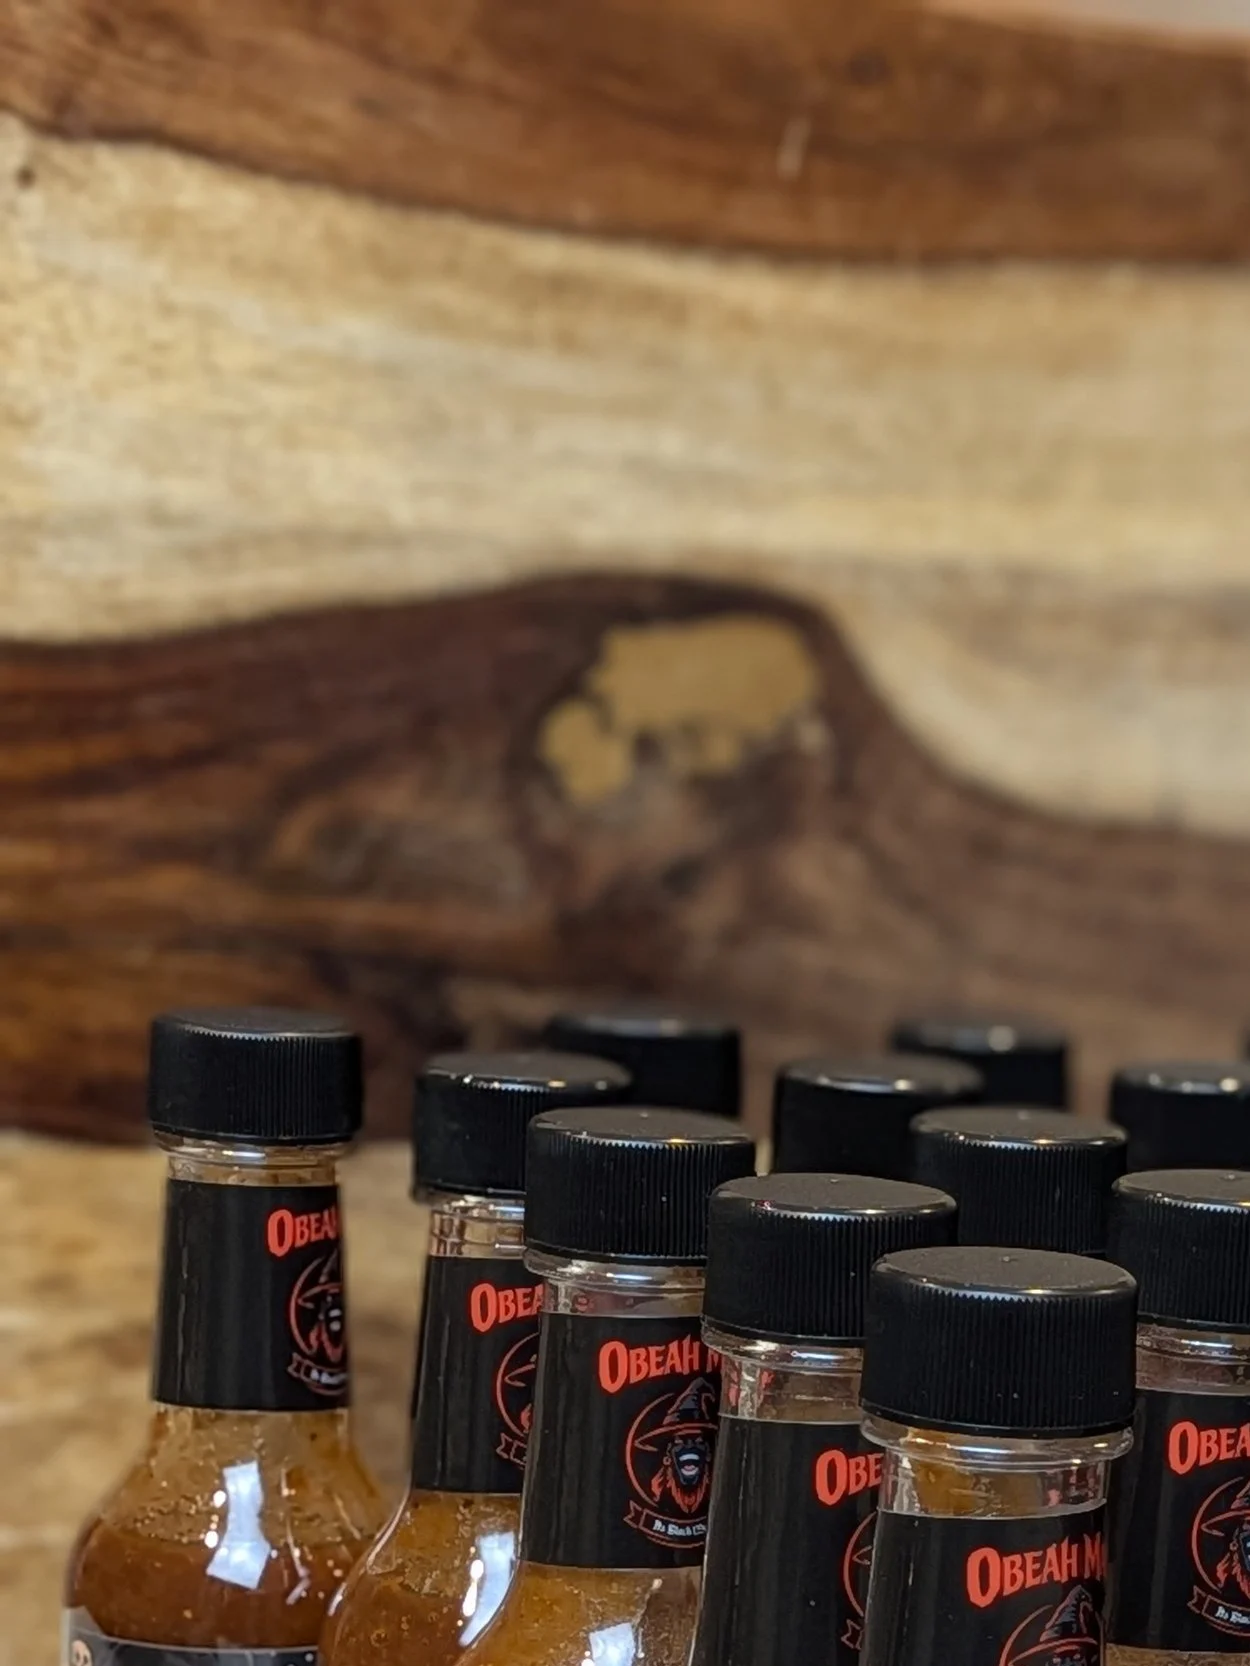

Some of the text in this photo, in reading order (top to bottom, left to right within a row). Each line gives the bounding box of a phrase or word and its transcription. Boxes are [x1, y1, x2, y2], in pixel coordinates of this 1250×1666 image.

[267, 1204, 337, 1257] OBEA
[470, 1282, 543, 1333] OBEA
[598, 1334, 700, 1394] OBEAH
[815, 1449, 885, 1506] OBE
[966, 1535, 1079, 1609] OBEAH
